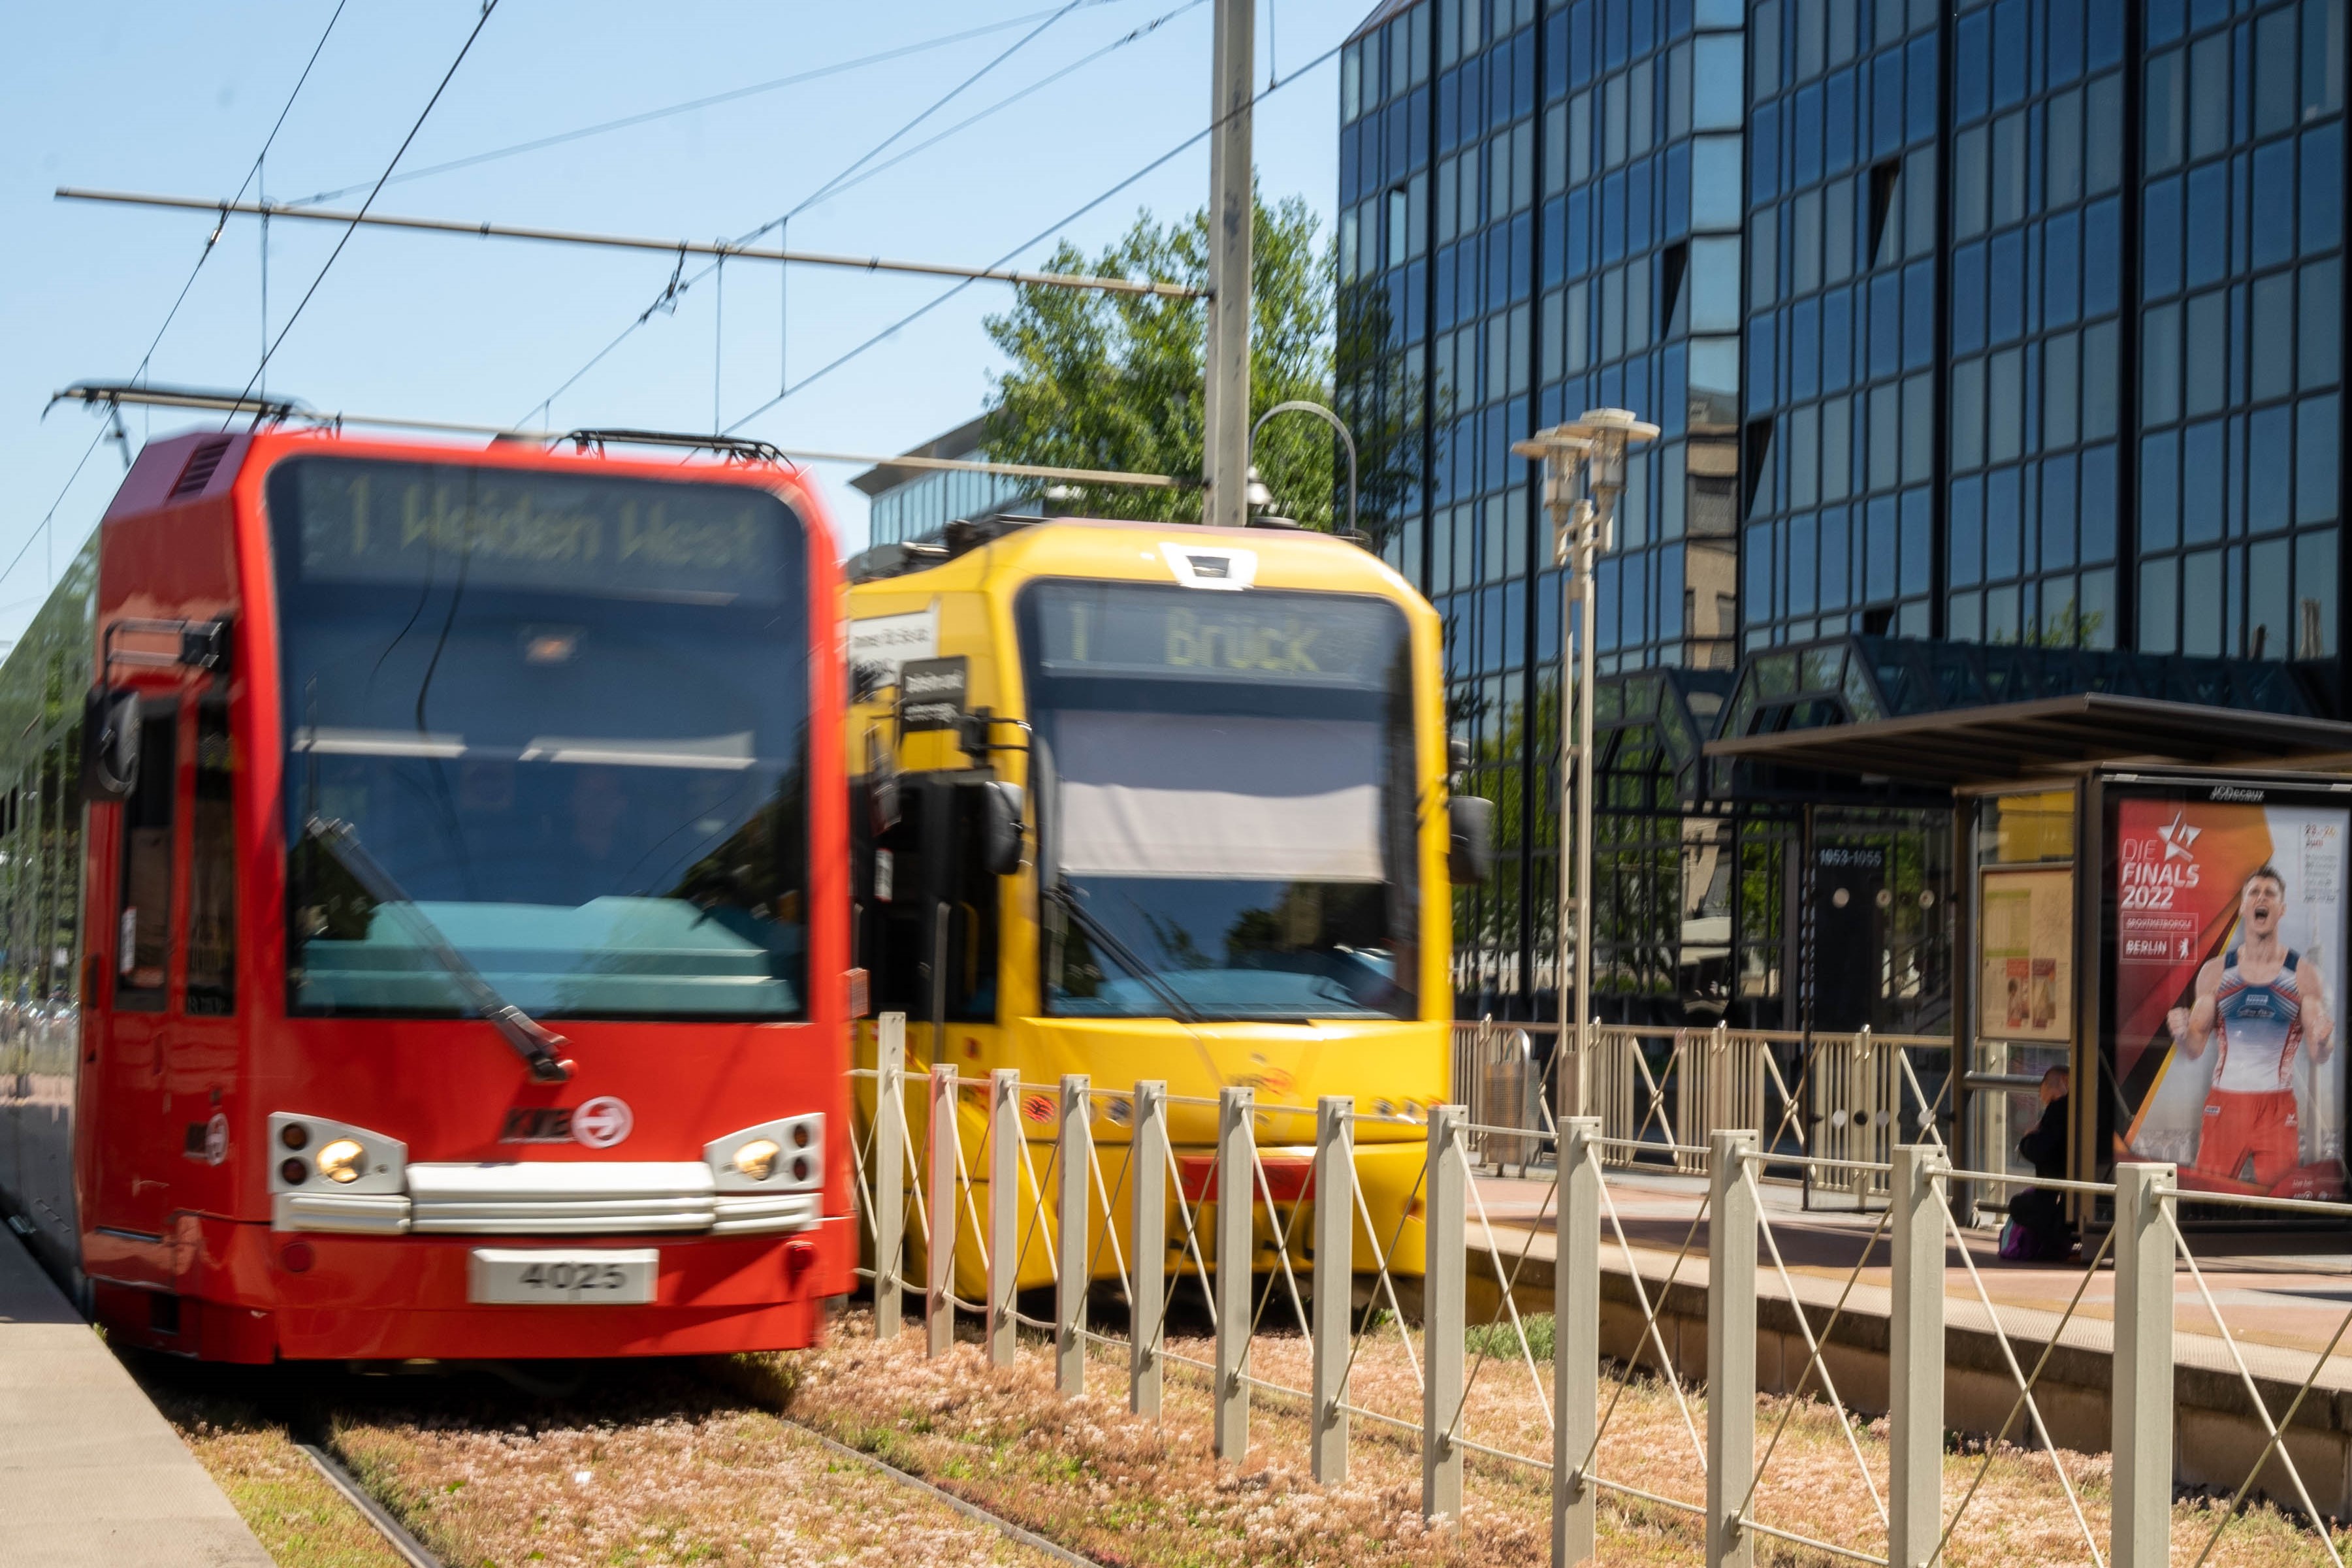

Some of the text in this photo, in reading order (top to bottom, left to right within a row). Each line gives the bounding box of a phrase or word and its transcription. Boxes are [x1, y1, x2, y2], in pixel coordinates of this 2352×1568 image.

[346, 473, 370, 556] 1
[1067, 601, 1321, 674] 1 Brück
[2210, 786, 2264, 801] JCDecaux
[2122, 839, 2158, 863] DIE
[2121, 861, 2200, 888] FINALS
[2121, 885, 2174, 910] 2022
[2126, 918, 2193, 930] SPORTMETROPOLE
[2126, 940, 2167, 955] BERLIN
[519, 1263, 627, 1290] 4025
